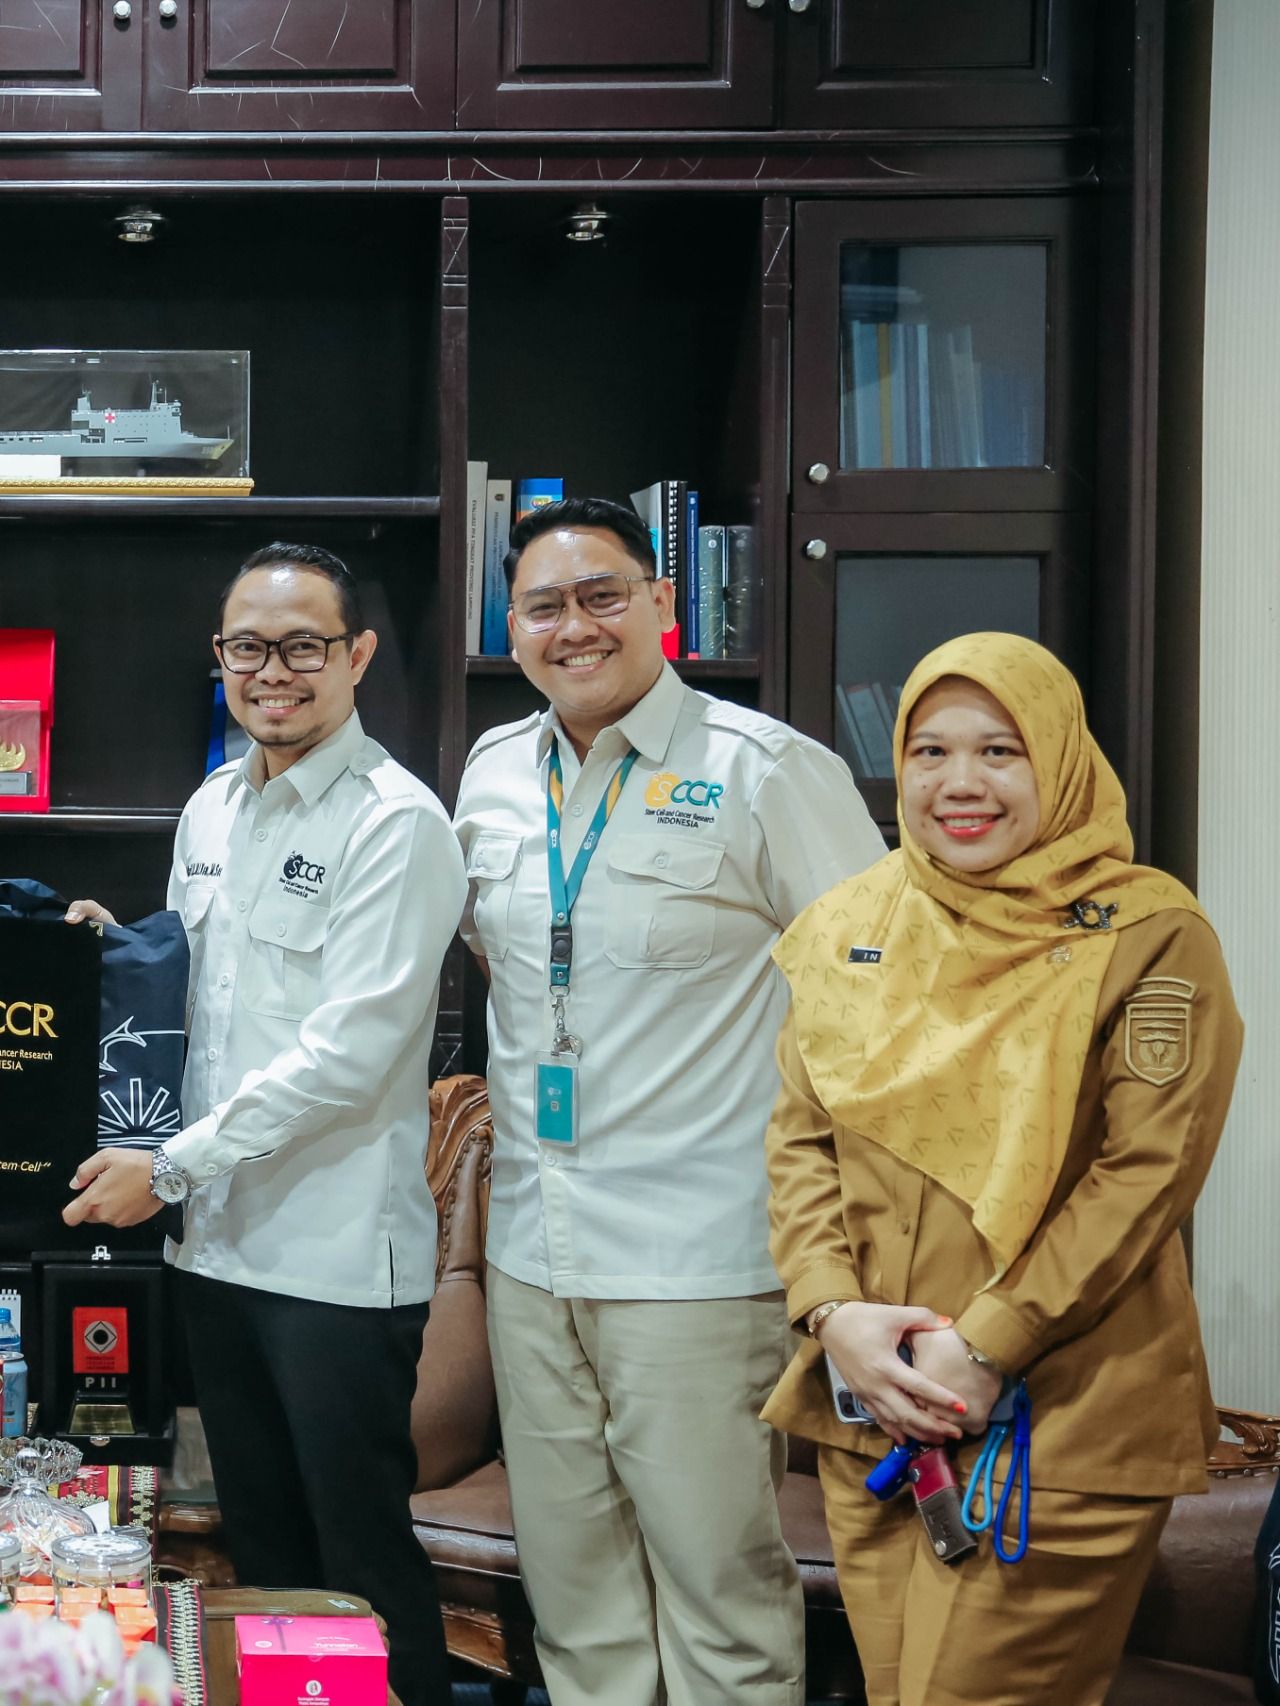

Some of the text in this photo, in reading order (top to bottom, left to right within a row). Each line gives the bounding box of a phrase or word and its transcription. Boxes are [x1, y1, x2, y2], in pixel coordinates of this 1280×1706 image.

[654, 780, 724, 809] SCCR
[657, 817, 699, 828] INDONESIA
[288, 859, 326, 884] SCCR
[19, 1049, 54, 1060] Research
